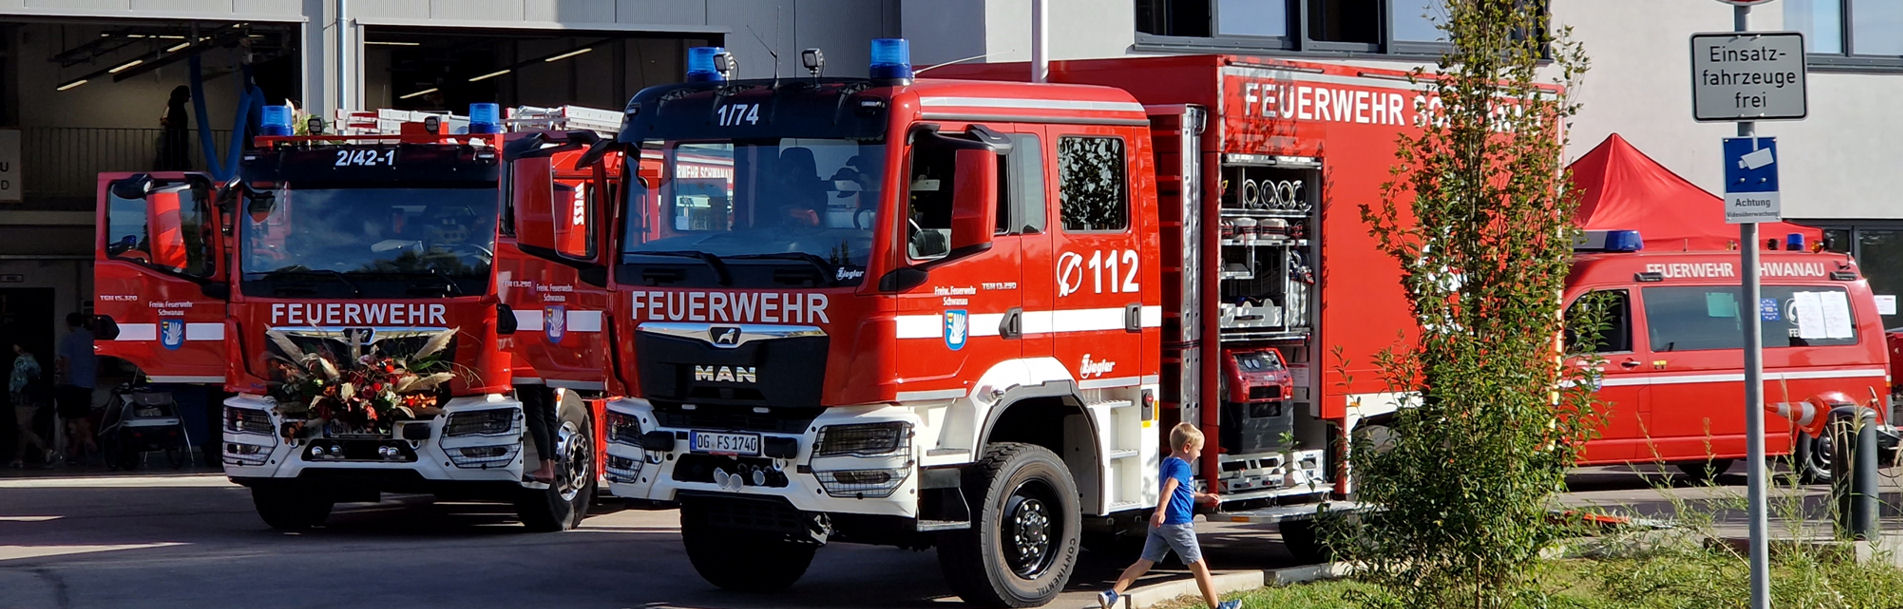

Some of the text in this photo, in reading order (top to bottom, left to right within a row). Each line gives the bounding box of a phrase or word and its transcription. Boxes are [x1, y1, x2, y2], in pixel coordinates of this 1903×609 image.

[1710, 46, 1787, 62] Einsatz-
[1702, 69, 1796, 88] fahrzeuge
[1246, 82, 1405, 126] FEUERWEHR
[1735, 91, 1767, 108] frei
[718, 103, 760, 127] 1/74
[335, 149, 395, 166] 2/42-1
[1735, 198, 1771, 208] Achtung
[1088, 249, 1140, 294] 112
[1645, 262, 1826, 278] FEUERWEHR HWANAU
[950, 286, 977, 296] Feuerwehr
[631, 290, 830, 324] FEUERWEHR
[943, 297, 968, 306] Schwanau
[271, 303, 447, 325] FEUERWEHR
[695, 365, 757, 383] MAN
[697, 434, 757, 452] OG FS 1740
[1036, 537, 1077, 596] CONTINENTAL
